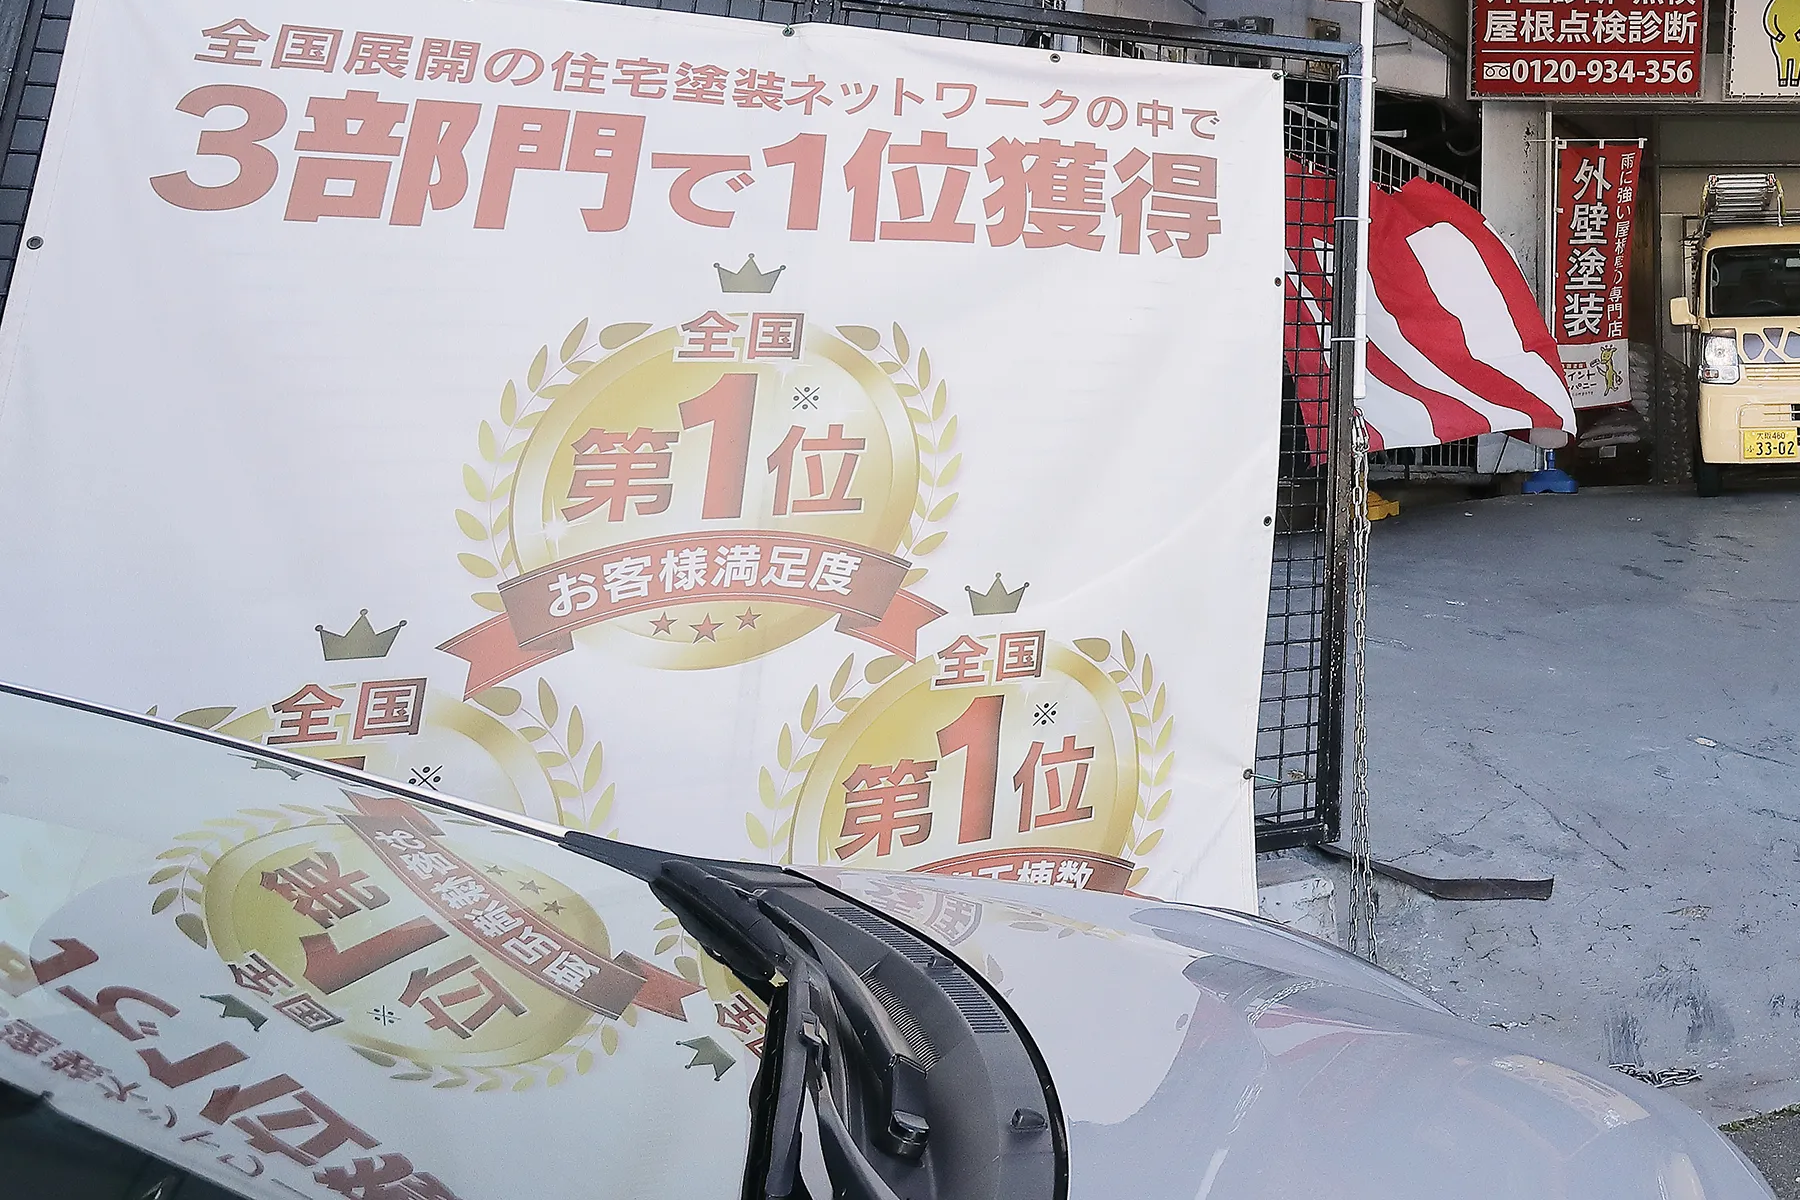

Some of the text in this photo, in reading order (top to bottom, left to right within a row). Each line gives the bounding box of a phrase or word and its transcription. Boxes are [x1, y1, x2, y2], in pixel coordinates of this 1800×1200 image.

[1483, 9, 1698, 45] 屋根点検診断
[194, 16, 1220, 142] 全国展開の住宅塗装ネットワークの中で
[1512, 58, 1693, 84] 0120-934-356
[148, 84, 1224, 260] 3部門で1位獲得
[1563, 156, 1613, 339] 外壁塗装
[678, 308, 807, 363] 全国
[1567, 369, 1596, 382] イント
[559, 372, 867, 522] 第1位
[1756, 440, 1795, 456] 33-02
[549, 542, 861, 618] お客様満足度
[934, 629, 1045, 687] 全国
[266, 676, 428, 746] 全国
[834, 693, 1096, 861] 第1位
